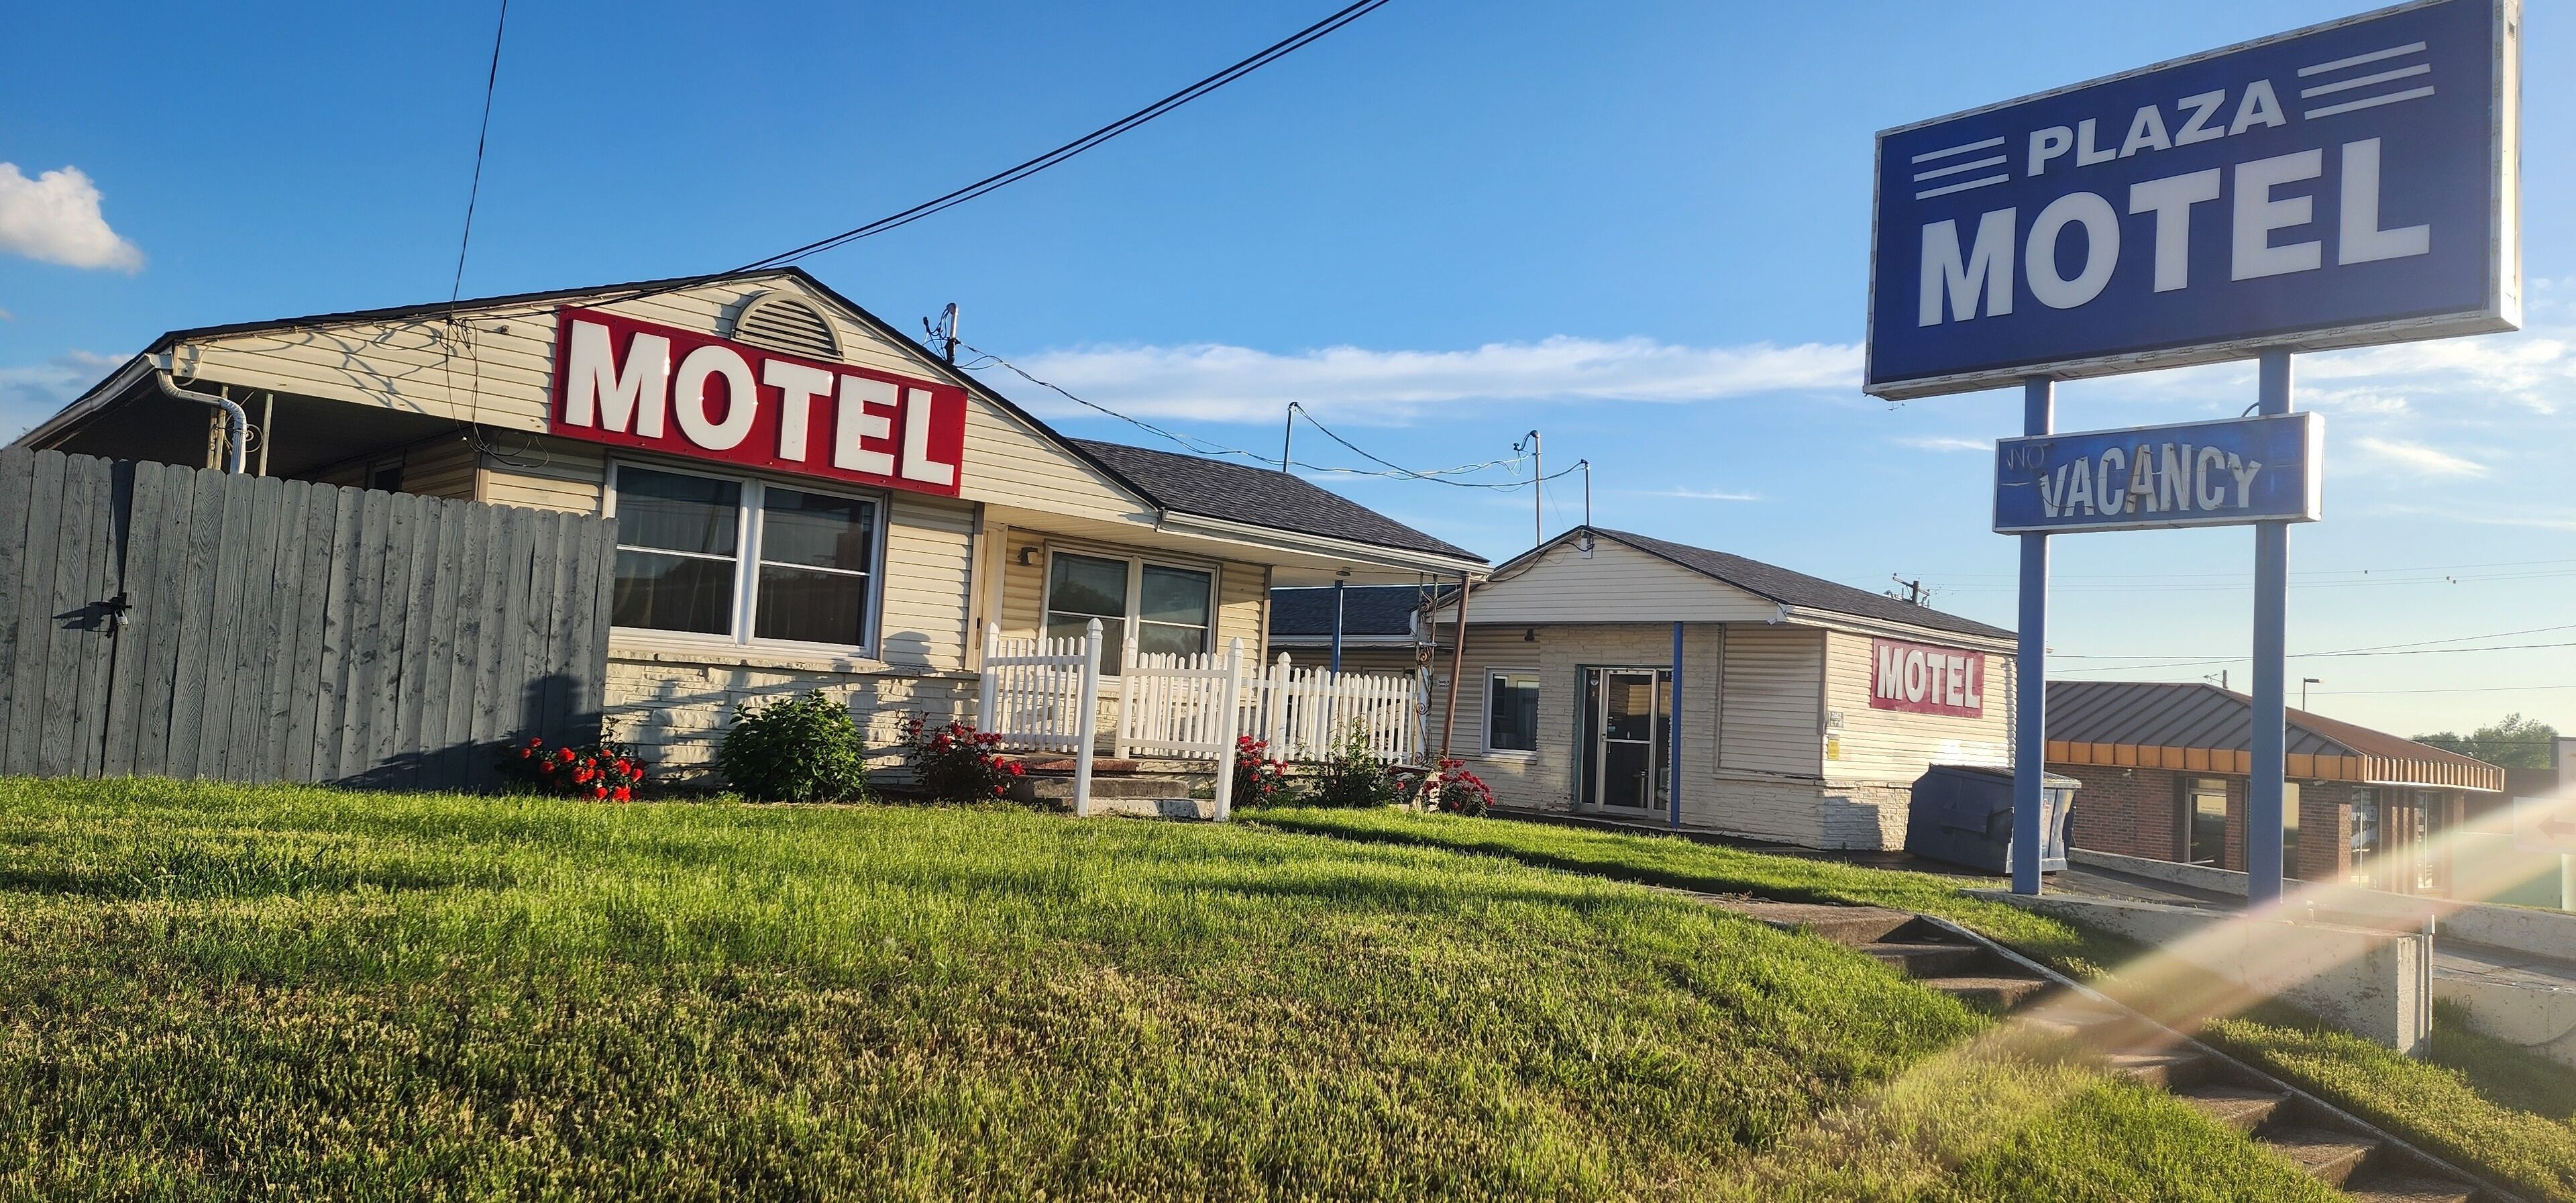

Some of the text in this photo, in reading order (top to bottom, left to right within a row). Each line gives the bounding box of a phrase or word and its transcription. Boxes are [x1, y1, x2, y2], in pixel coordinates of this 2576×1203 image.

[2028, 79, 2287, 177] PLAZA
[1919, 138, 2430, 327] MOTEL
[565, 319, 955, 486] MOTEL
[2008, 442, 2262, 517] NO VACANCY
[1876, 645, 1980, 709] MOTEL
